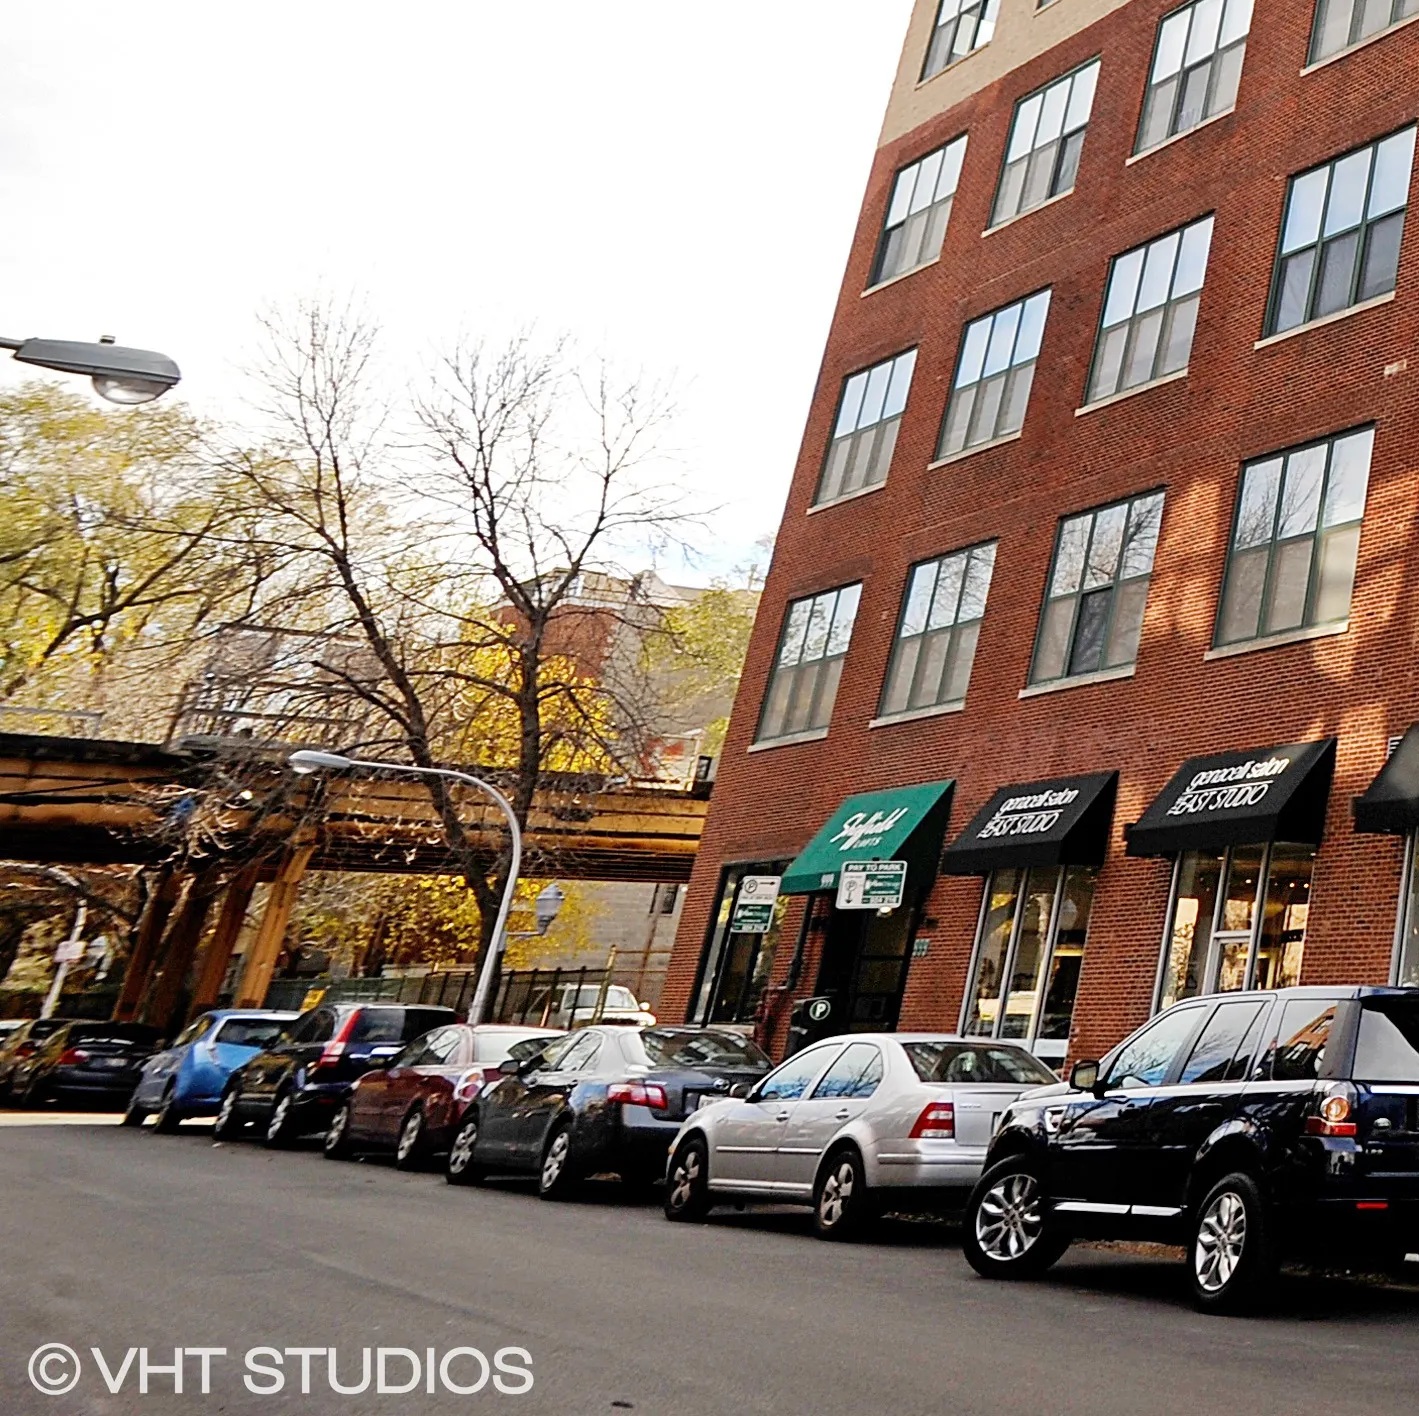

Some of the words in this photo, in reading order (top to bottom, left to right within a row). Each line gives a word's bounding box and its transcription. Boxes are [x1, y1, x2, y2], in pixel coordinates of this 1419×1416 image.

[1186, 760, 1256, 793] genacelli
[1246, 757, 1290, 779] salon
[1174, 789, 1218, 815] EAST
[1208, 783, 1269, 811] STUDIO
[1009, 812, 1060, 835] STUDIO
[848, 864, 864, 872] PAY
[866, 864, 878, 872] TO
[878, 863, 902, 871] PARK
